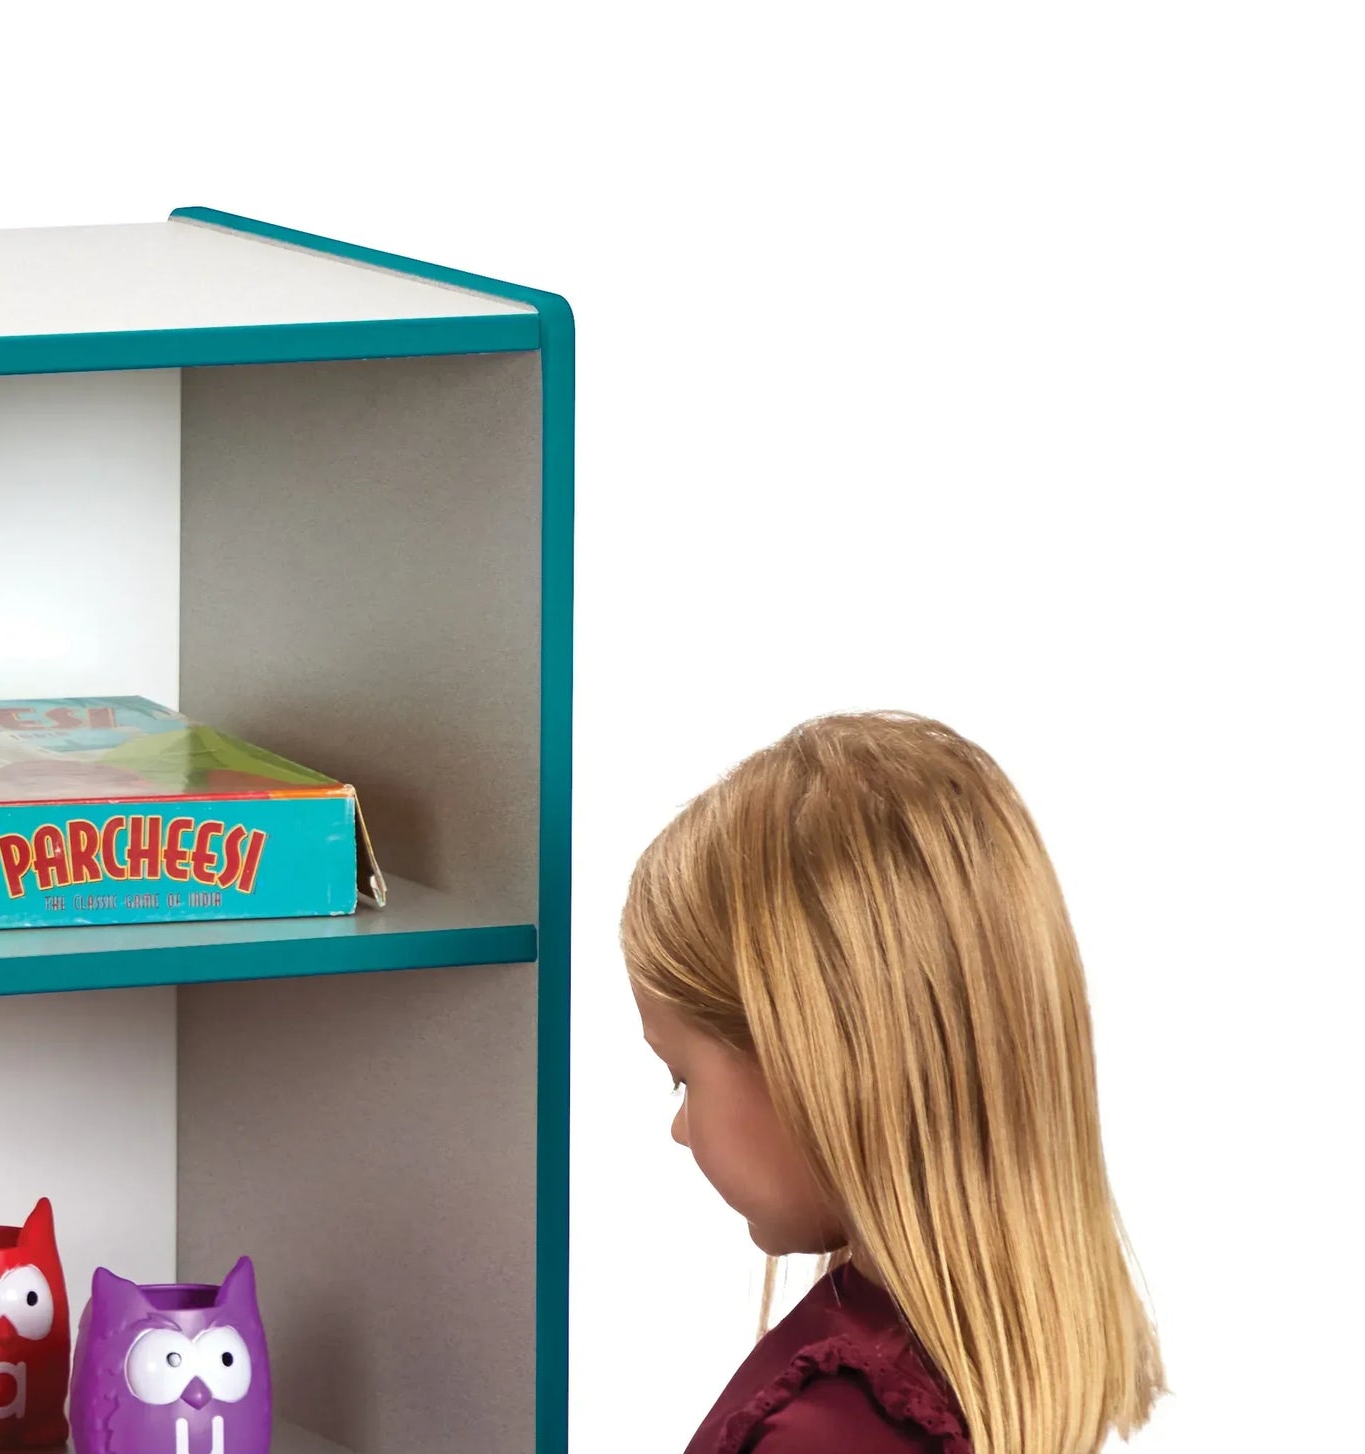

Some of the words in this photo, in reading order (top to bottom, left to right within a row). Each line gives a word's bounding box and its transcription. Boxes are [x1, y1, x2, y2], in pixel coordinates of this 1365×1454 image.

[44, 896, 66, 910] THE
[74, 894, 117, 910] CLASSIC
[125, 893, 160, 908] GAME
[167, 893, 181, 908] OF
[189, 892, 222, 907] INDIA
